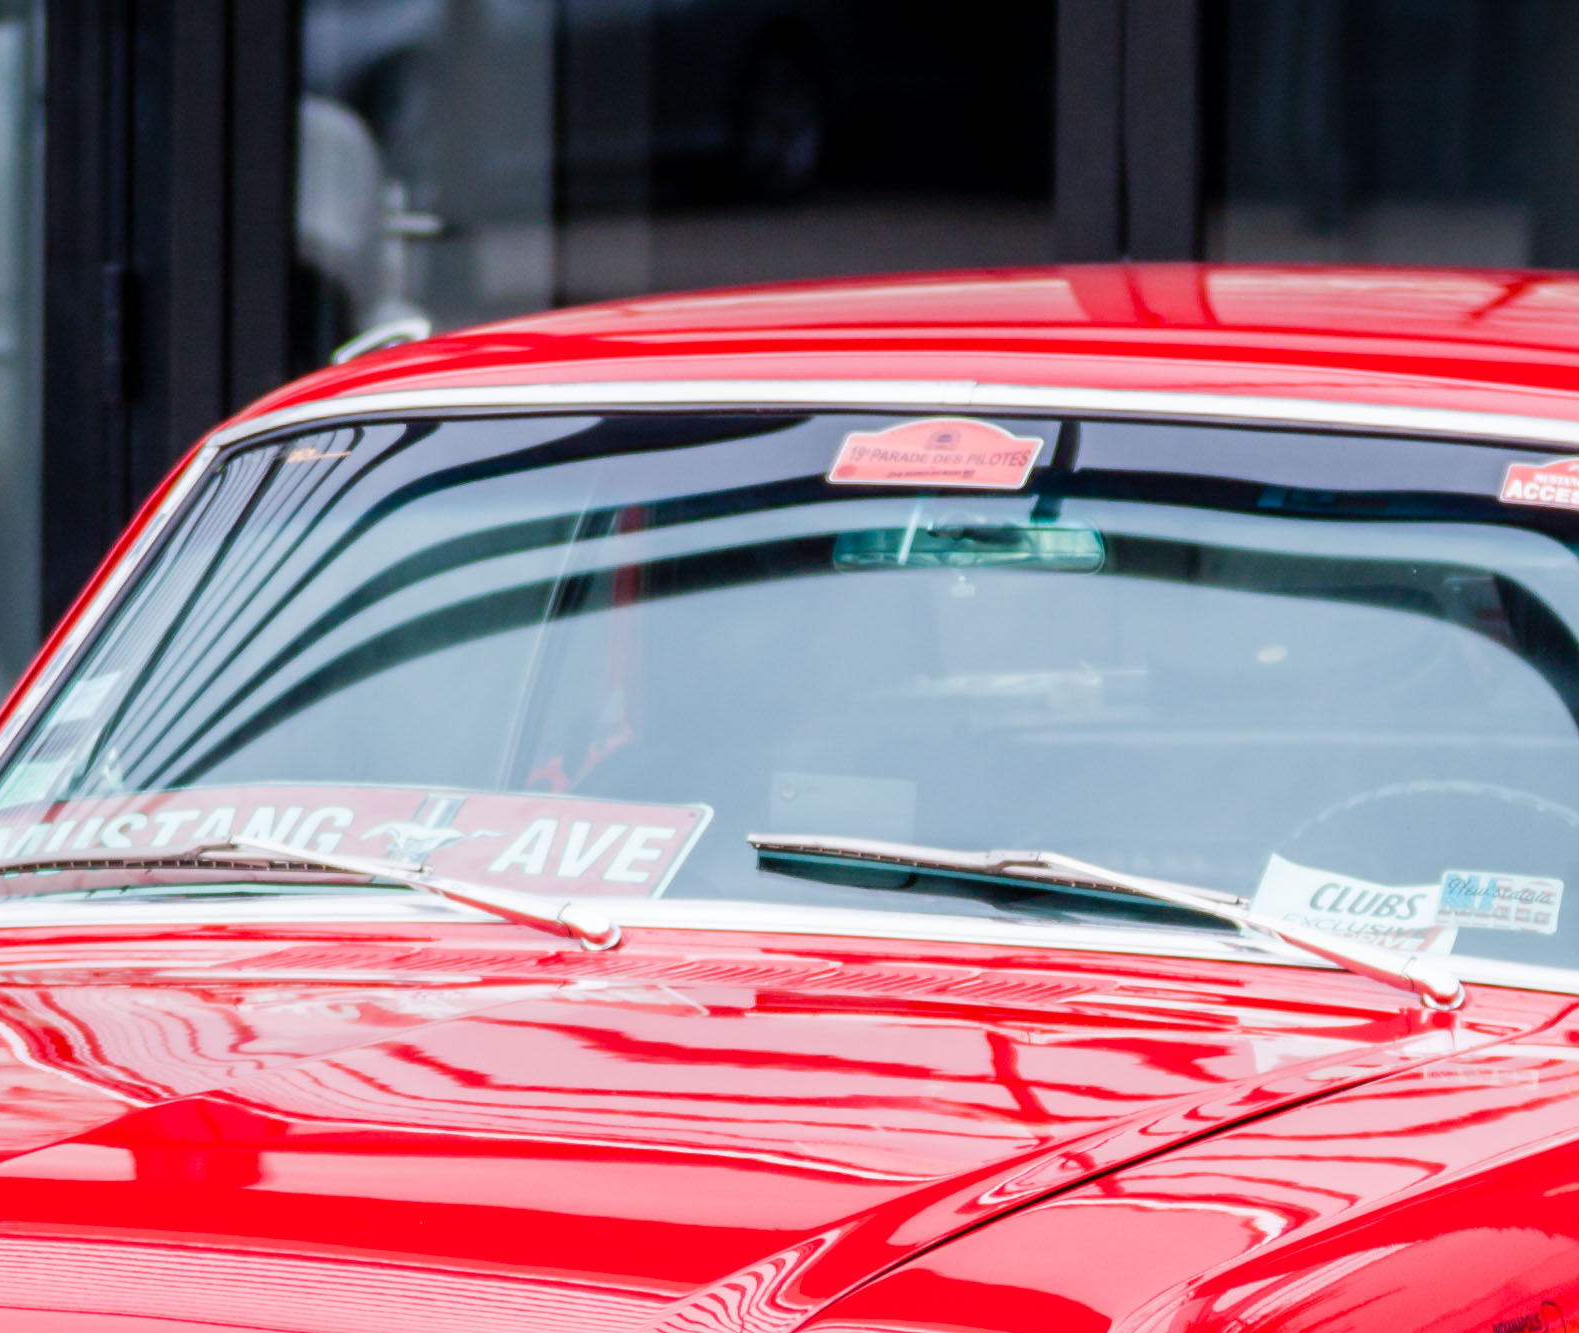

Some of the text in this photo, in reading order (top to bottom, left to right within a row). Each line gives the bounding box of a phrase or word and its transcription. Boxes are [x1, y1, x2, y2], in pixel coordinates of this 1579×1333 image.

[870, 448, 927, 463] PARADE
[932, 453, 963, 464] DES
[966, 449, 1032, 466] PILOTES
[487, 817, 678, 882] AVE
[1309, 882, 1428, 920] CLUBS
